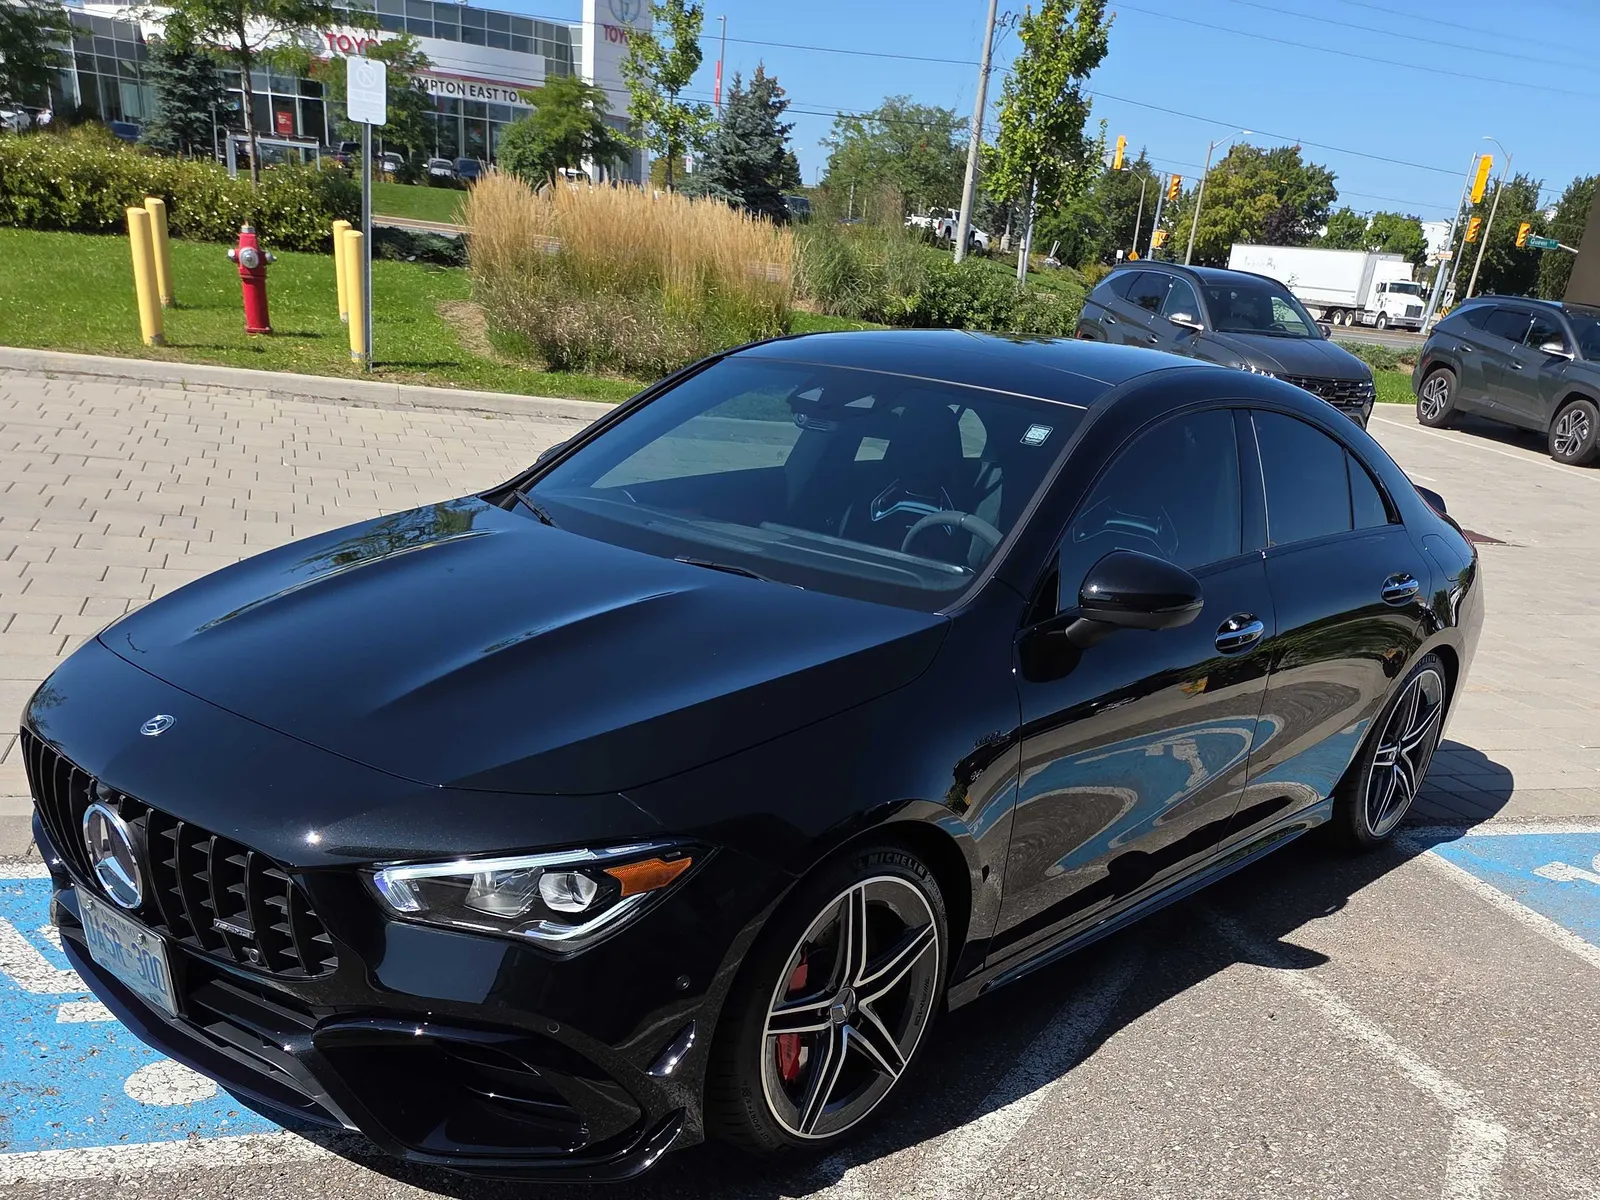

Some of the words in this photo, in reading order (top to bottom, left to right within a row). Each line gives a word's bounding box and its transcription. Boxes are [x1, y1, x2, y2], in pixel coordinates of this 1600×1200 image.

[470, 85, 499, 100] EAST
[867, 852, 925, 876] MICHELIN
[131, 942, 168, 996] 300
[748, 1110, 763, 1131] SPORT
